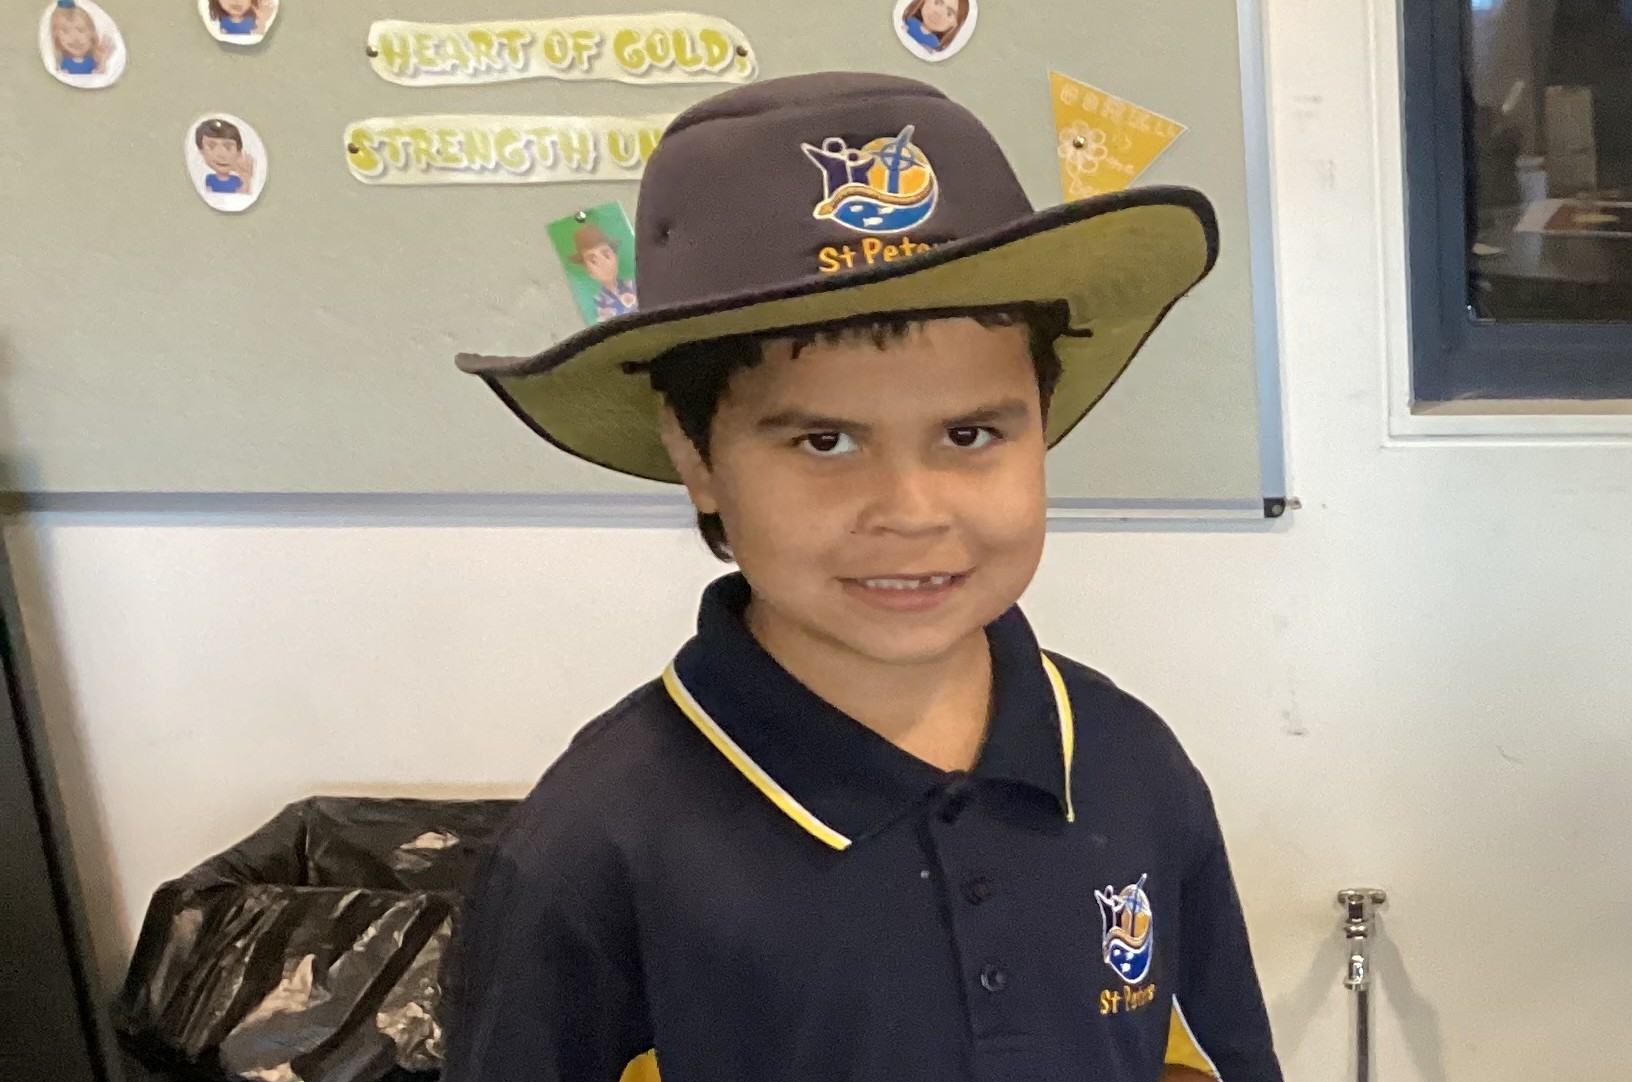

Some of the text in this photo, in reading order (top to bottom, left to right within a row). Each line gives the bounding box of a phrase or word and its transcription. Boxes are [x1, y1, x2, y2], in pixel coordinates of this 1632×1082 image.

[378, 27, 752, 76] HEART OF GOLD,
[347, 127, 597, 174] STRENGTH
[819, 245, 856, 272] St
[1100, 990, 1121, 1015] St
